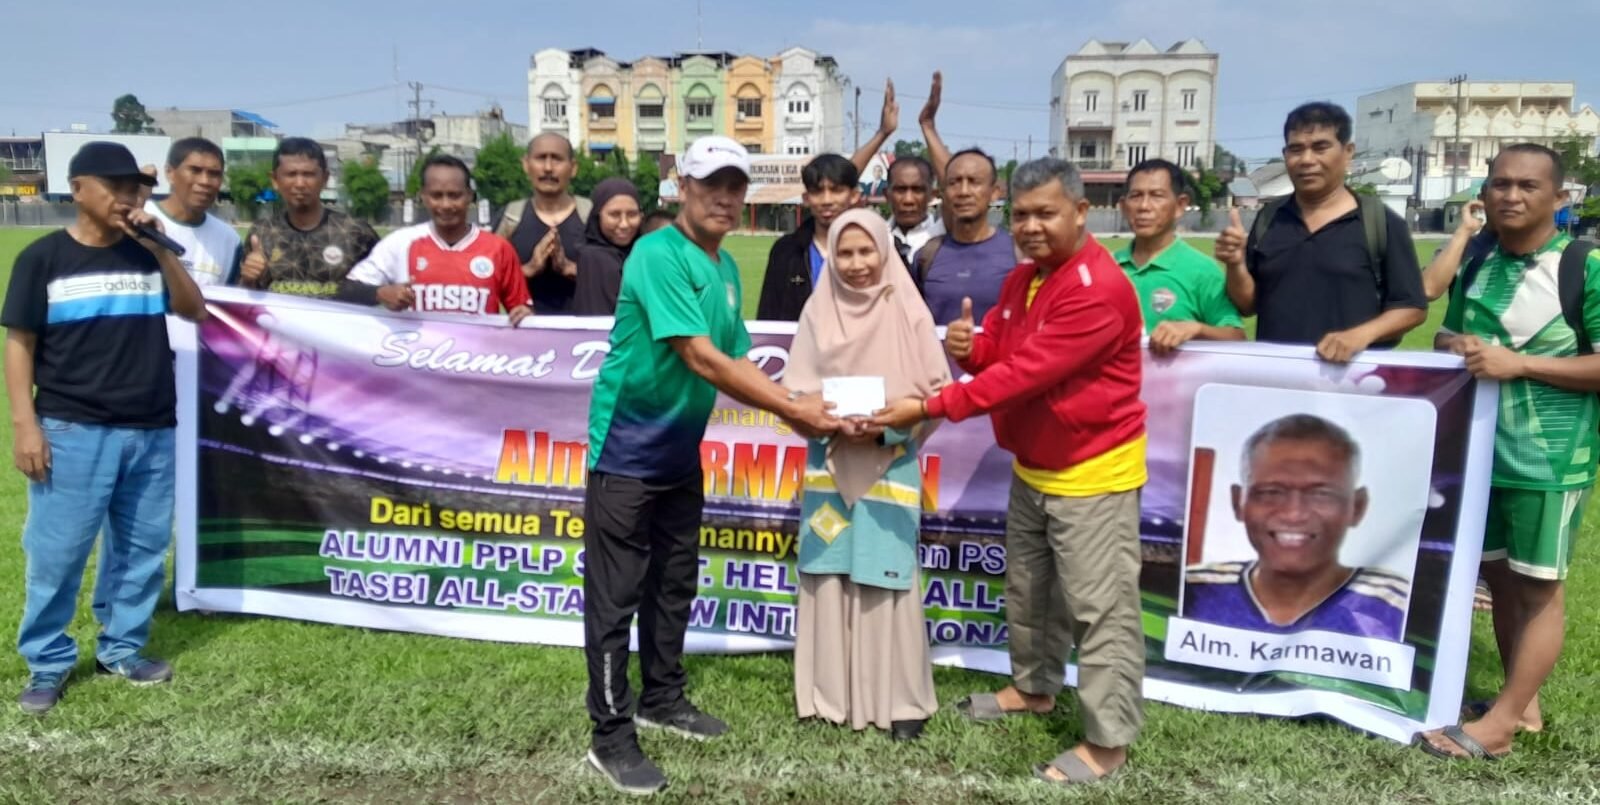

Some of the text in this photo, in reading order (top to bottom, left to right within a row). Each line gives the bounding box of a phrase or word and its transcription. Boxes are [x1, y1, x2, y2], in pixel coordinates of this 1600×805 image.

[104, 280, 151, 292] adidas
[411, 284, 490, 318] TASBI
[373, 331, 557, 378] Selamat
[370, 497, 431, 527] Dari
[439, 508, 541, 536] semua
[550, 509, 584, 538] Te
[319, 530, 461, 568] ALUMNI
[473, 540, 564, 575] PPLP
[724, 560, 798, 594] HEL
[324, 565, 429, 604] TASBI
[436, 576, 585, 616] ALL-STA
[727, 599, 798, 636] INT
[1180, 630, 1392, 673] Alm. Karmawan
